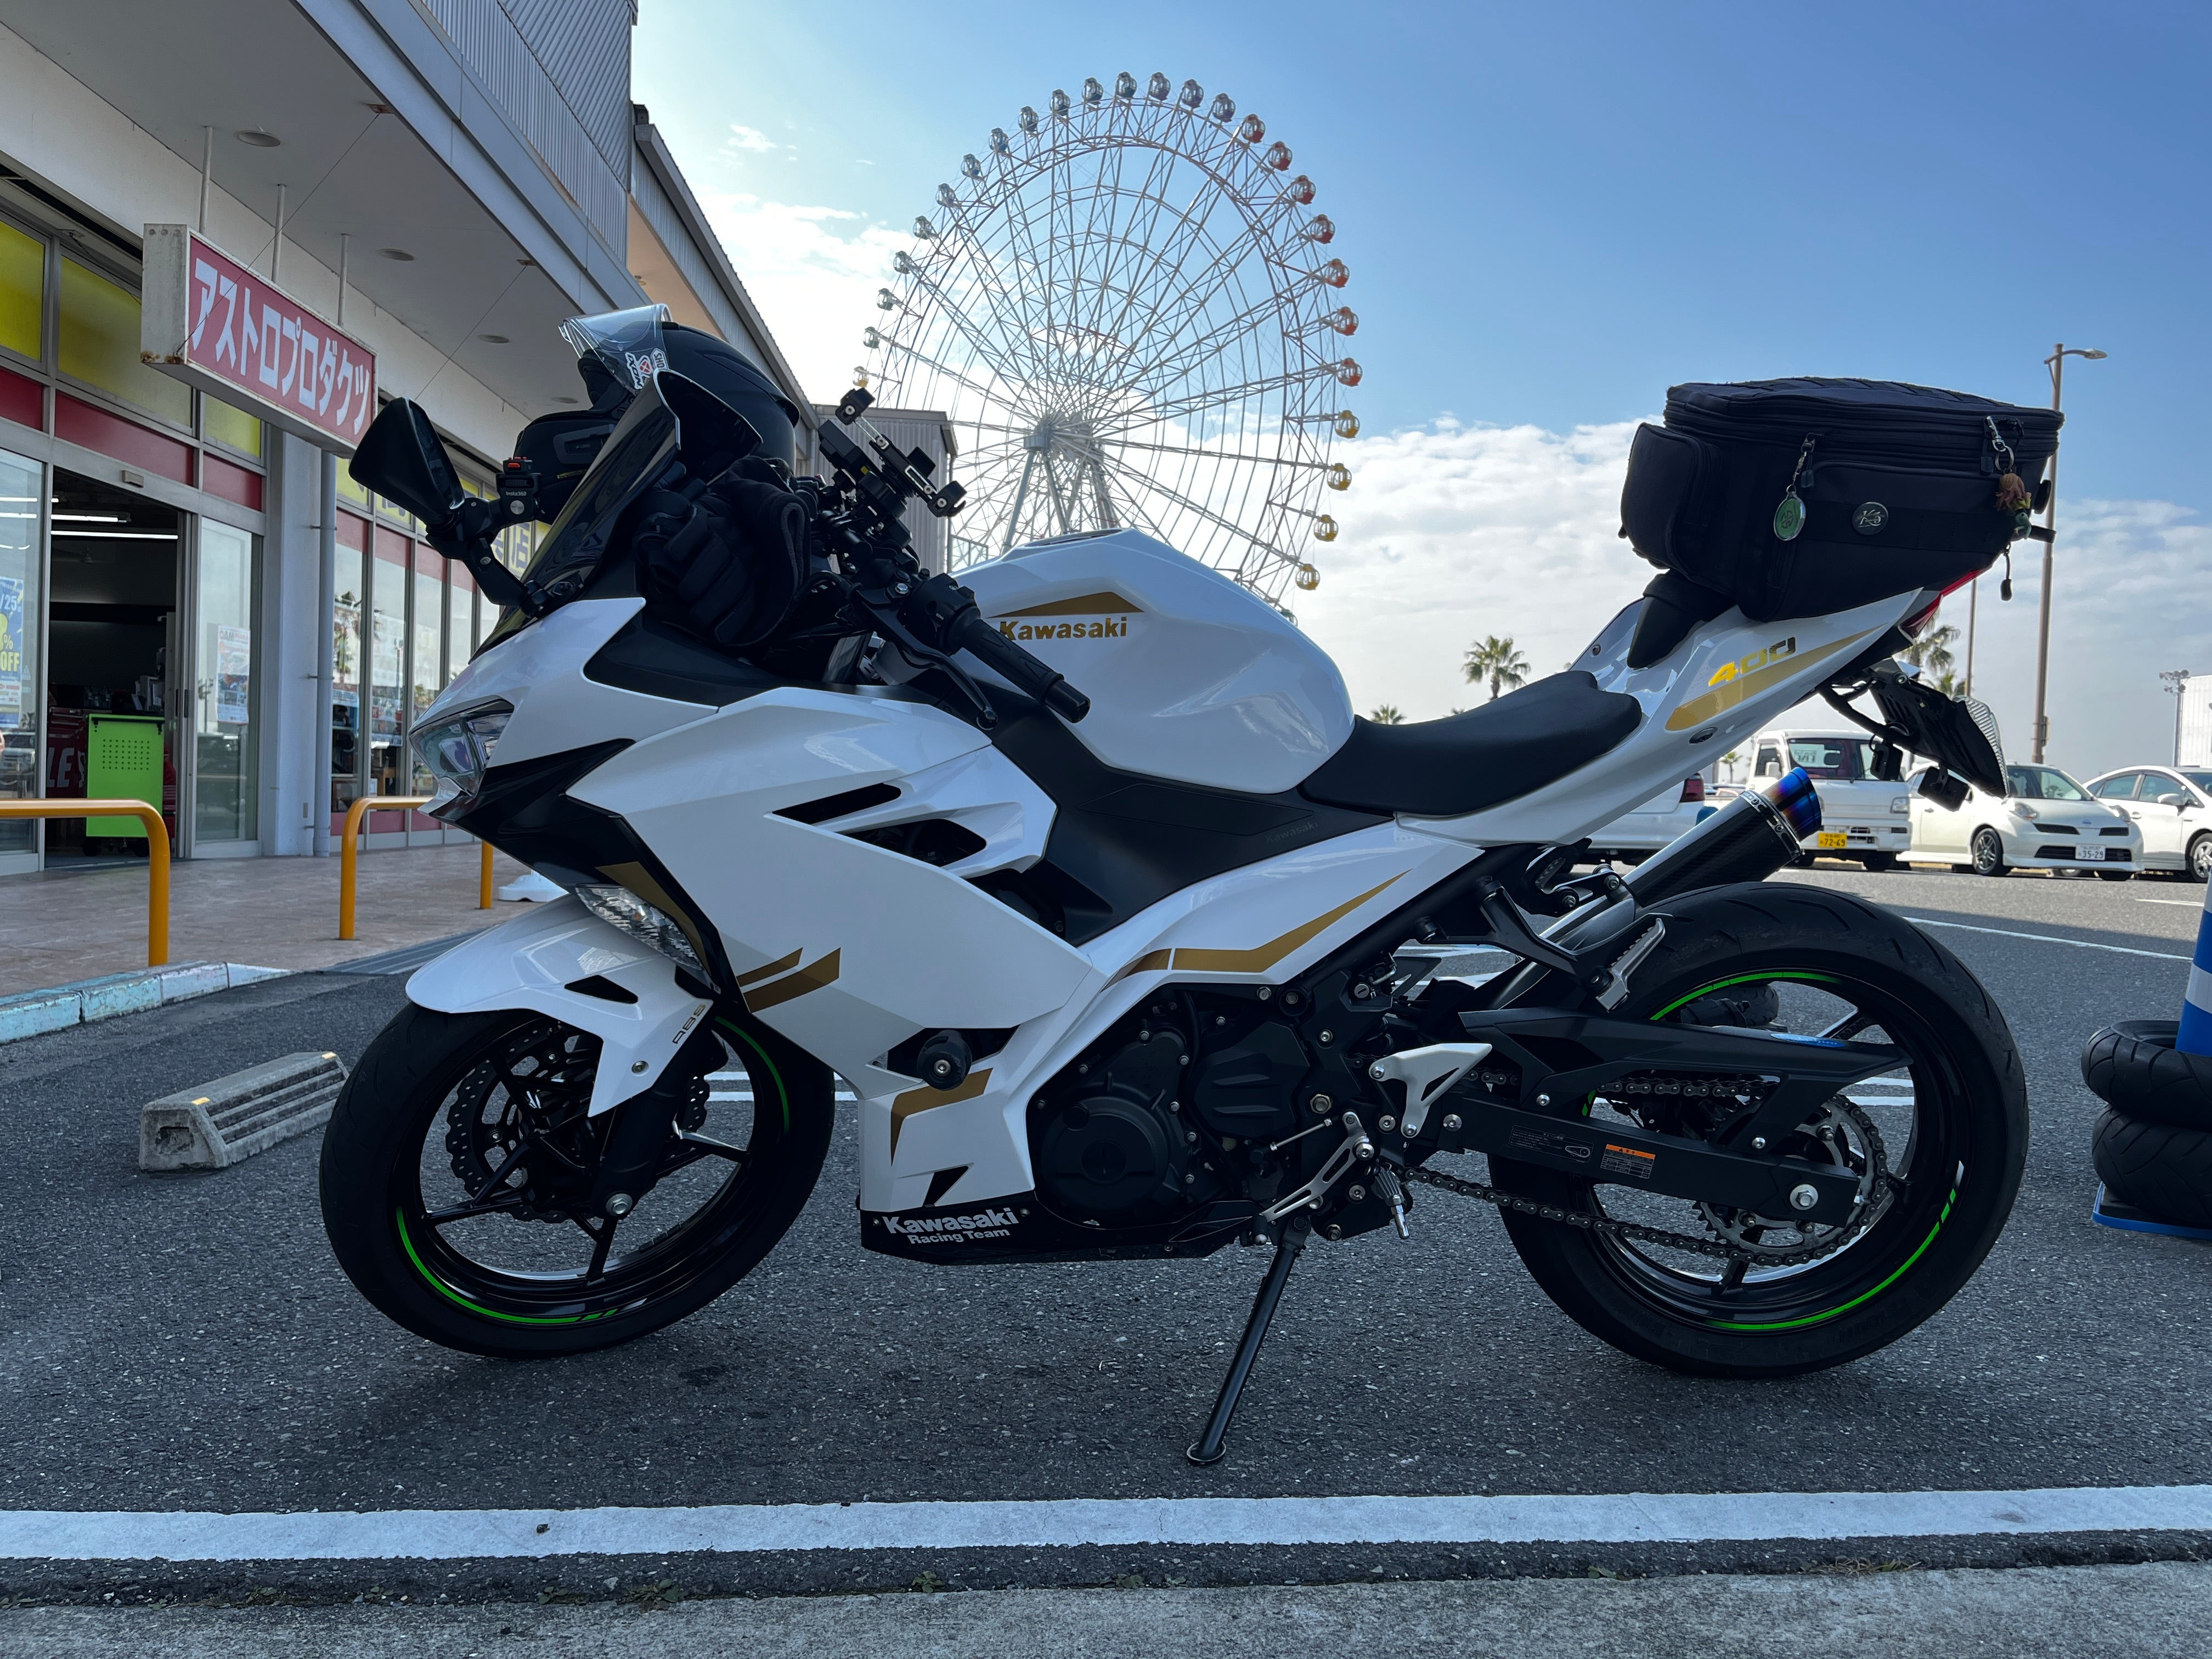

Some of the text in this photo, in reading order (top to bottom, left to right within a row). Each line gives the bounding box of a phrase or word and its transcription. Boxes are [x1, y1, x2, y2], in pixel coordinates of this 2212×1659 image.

[191, 257, 370, 435] アストロプロダクツ
[627, 354, 643, 387] IXON
[653, 353, 665, 368] SHO
[1000, 616, 1128, 641] Kawasaki
[1, 652, 20, 673] OFF
[1708, 636, 1796, 687] 400
[1265, 821, 1319, 843] Kawasaki
[2082, 850, 2104, 859] 35-29
[672, 1004, 706, 1045] ABS
[881, 1207, 1019, 1234] Kawasaki
[907, 1228, 1011, 1244] Racing Team
